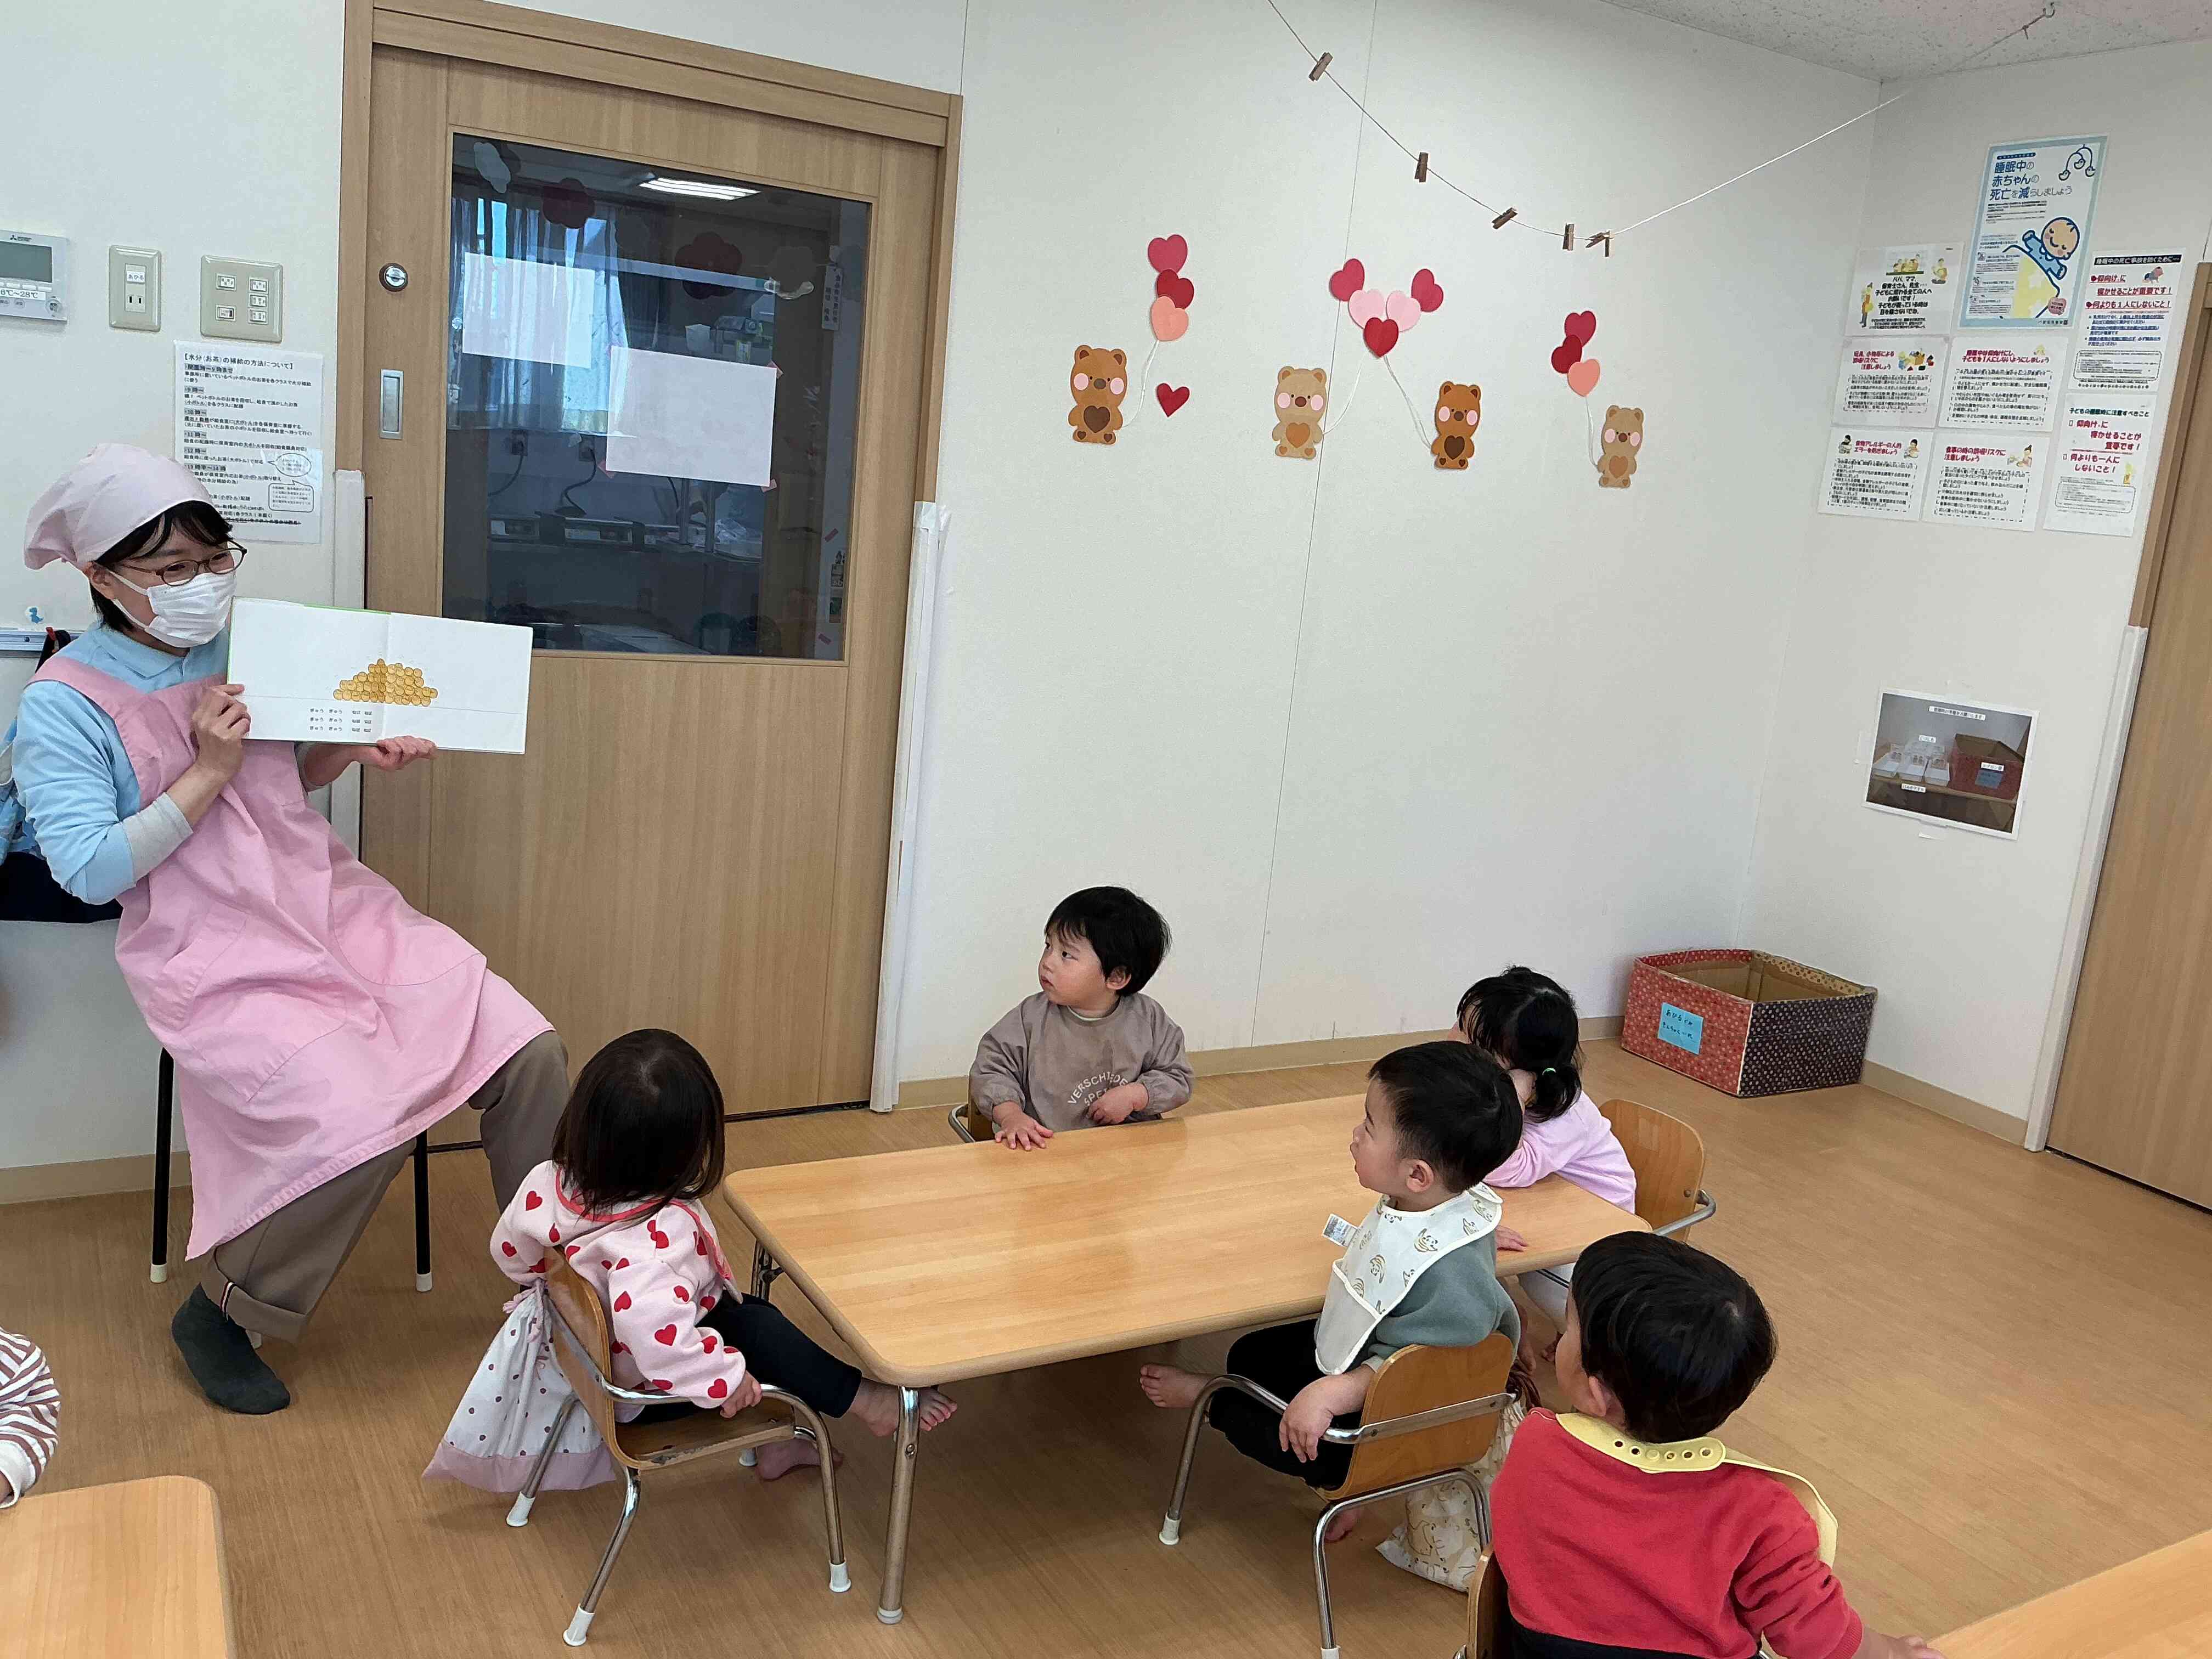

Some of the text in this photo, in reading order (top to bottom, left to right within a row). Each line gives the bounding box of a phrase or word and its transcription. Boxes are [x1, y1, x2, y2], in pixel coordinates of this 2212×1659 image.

[1994, 160, 2035, 173] 睡眠中の
[1992, 173, 2039, 186] 赤ちゃんの
[1989, 186, 2072, 201] 死亡を減らしましょう
